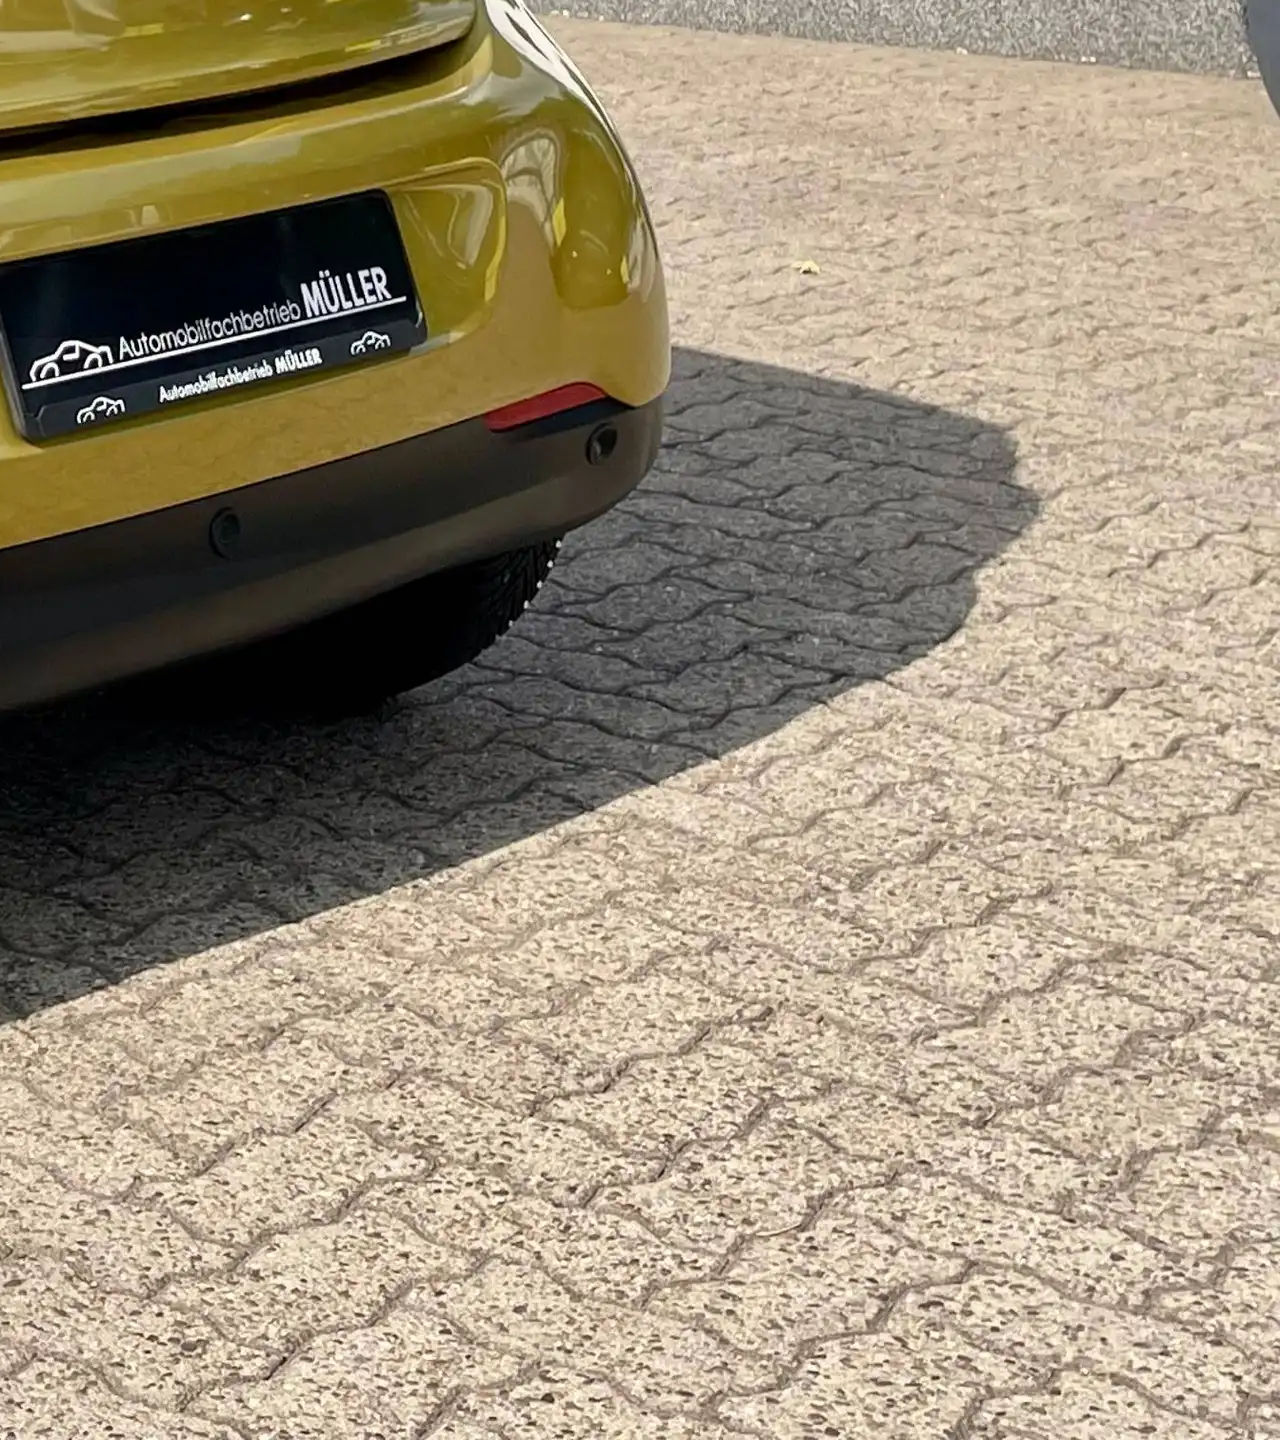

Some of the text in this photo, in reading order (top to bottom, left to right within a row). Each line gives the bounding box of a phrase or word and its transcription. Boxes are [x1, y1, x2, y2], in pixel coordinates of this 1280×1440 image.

[118, 266, 393, 362] Automobilfachbetrieb MÜLLER
[158, 347, 323, 404] Automobilfachbetrieb MÜLLER
